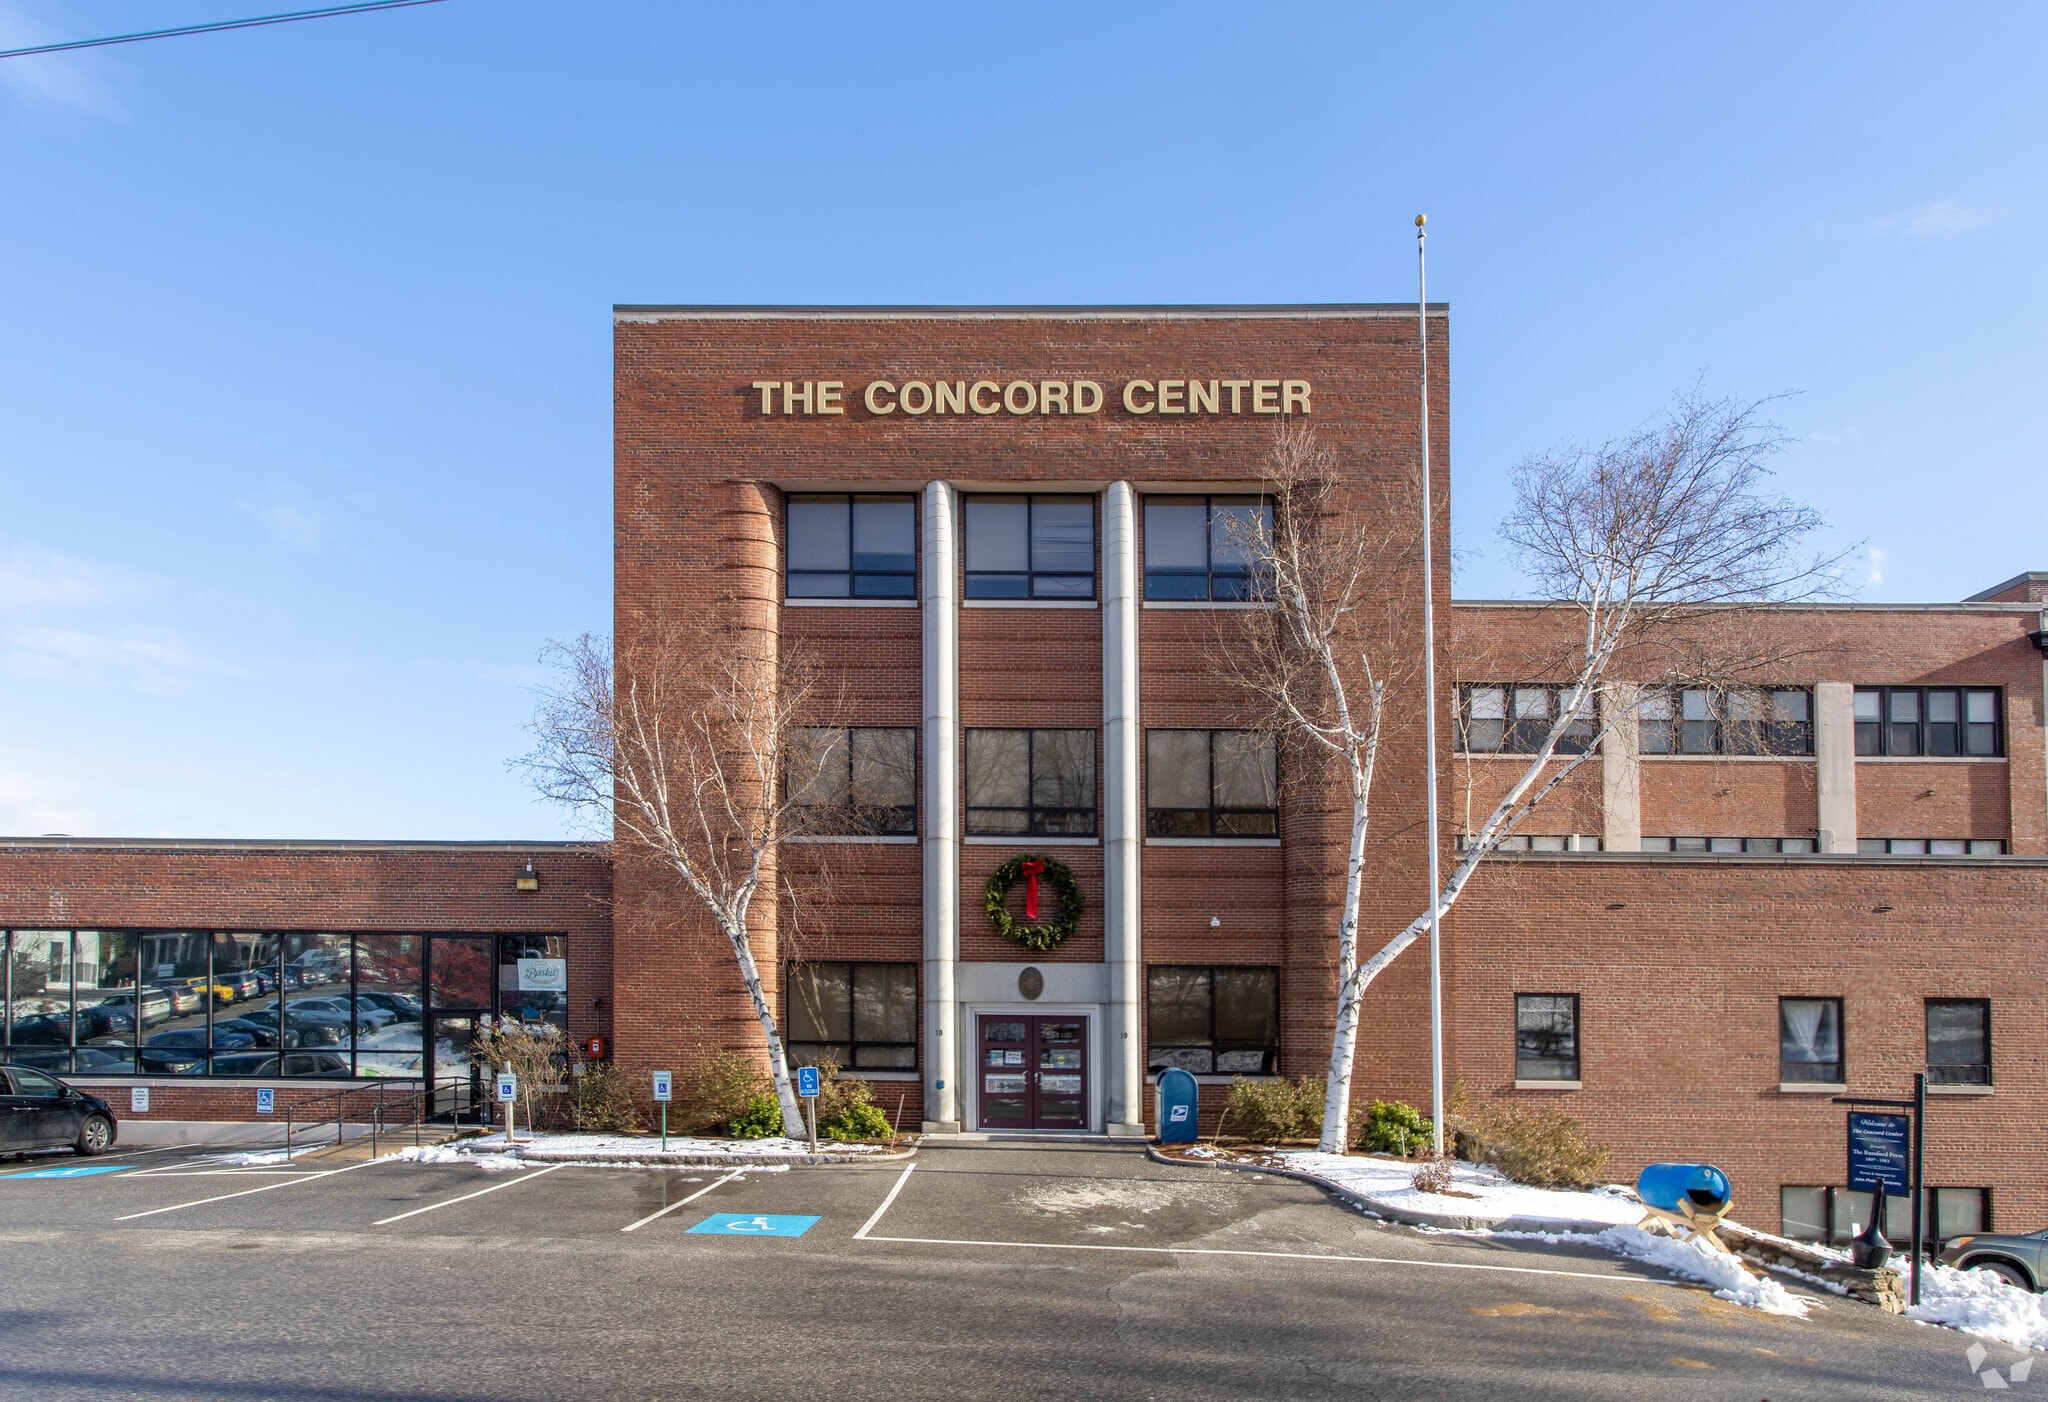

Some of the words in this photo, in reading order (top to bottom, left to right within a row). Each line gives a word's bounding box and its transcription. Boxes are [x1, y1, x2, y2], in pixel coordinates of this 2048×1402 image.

[752, 381, 844, 415] THE
[864, 380, 1103, 416] CONCORD
[1123, 380, 1312, 415] CENTER
[524, 967, 557, 979] Baskit
[1860, 1119, 1887, 1127] Welcome
